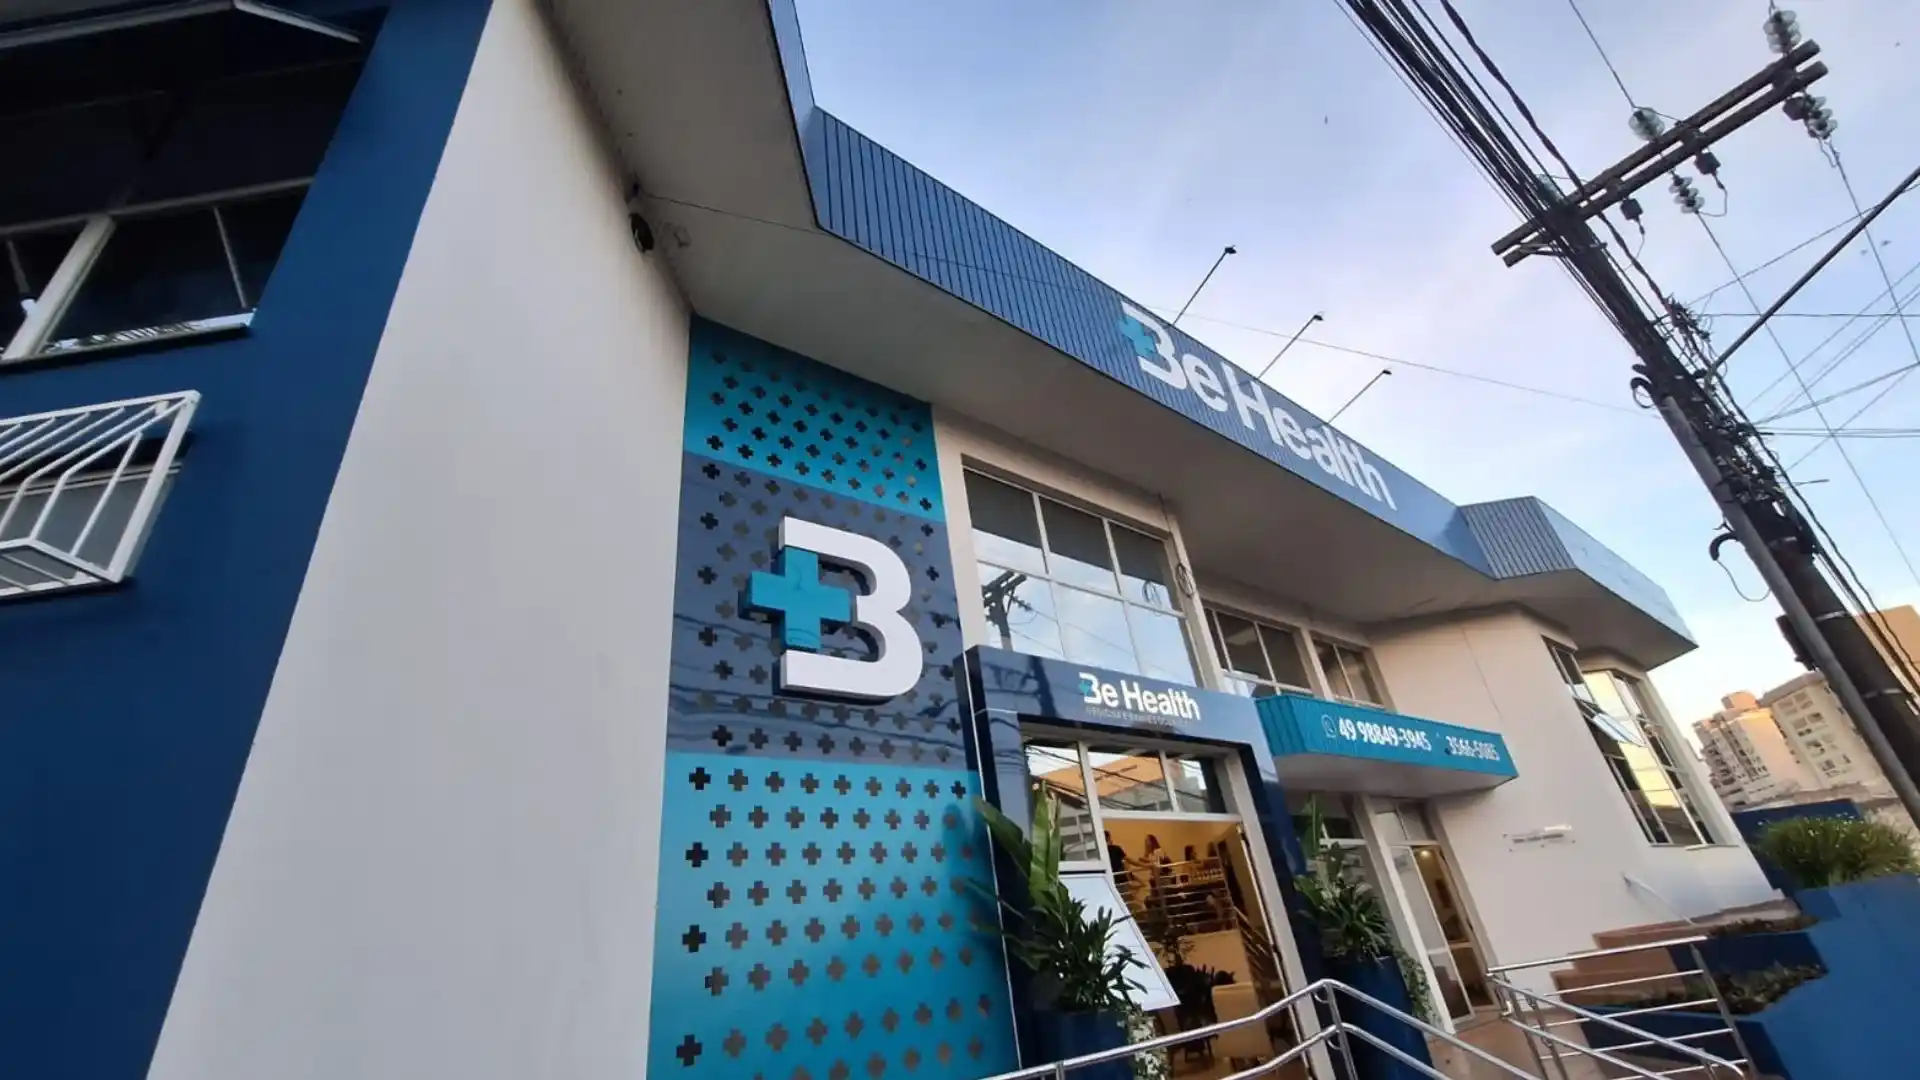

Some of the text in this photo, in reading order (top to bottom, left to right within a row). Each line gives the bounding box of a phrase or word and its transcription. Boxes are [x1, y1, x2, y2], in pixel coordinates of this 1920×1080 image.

[1121, 300, 1397, 511] Be Health
[777, 516, 923, 697] B
[1079, 672, 1119, 707] Be
[1120, 680, 1201, 720] Health
[1338, 717, 1357, 741] 49
